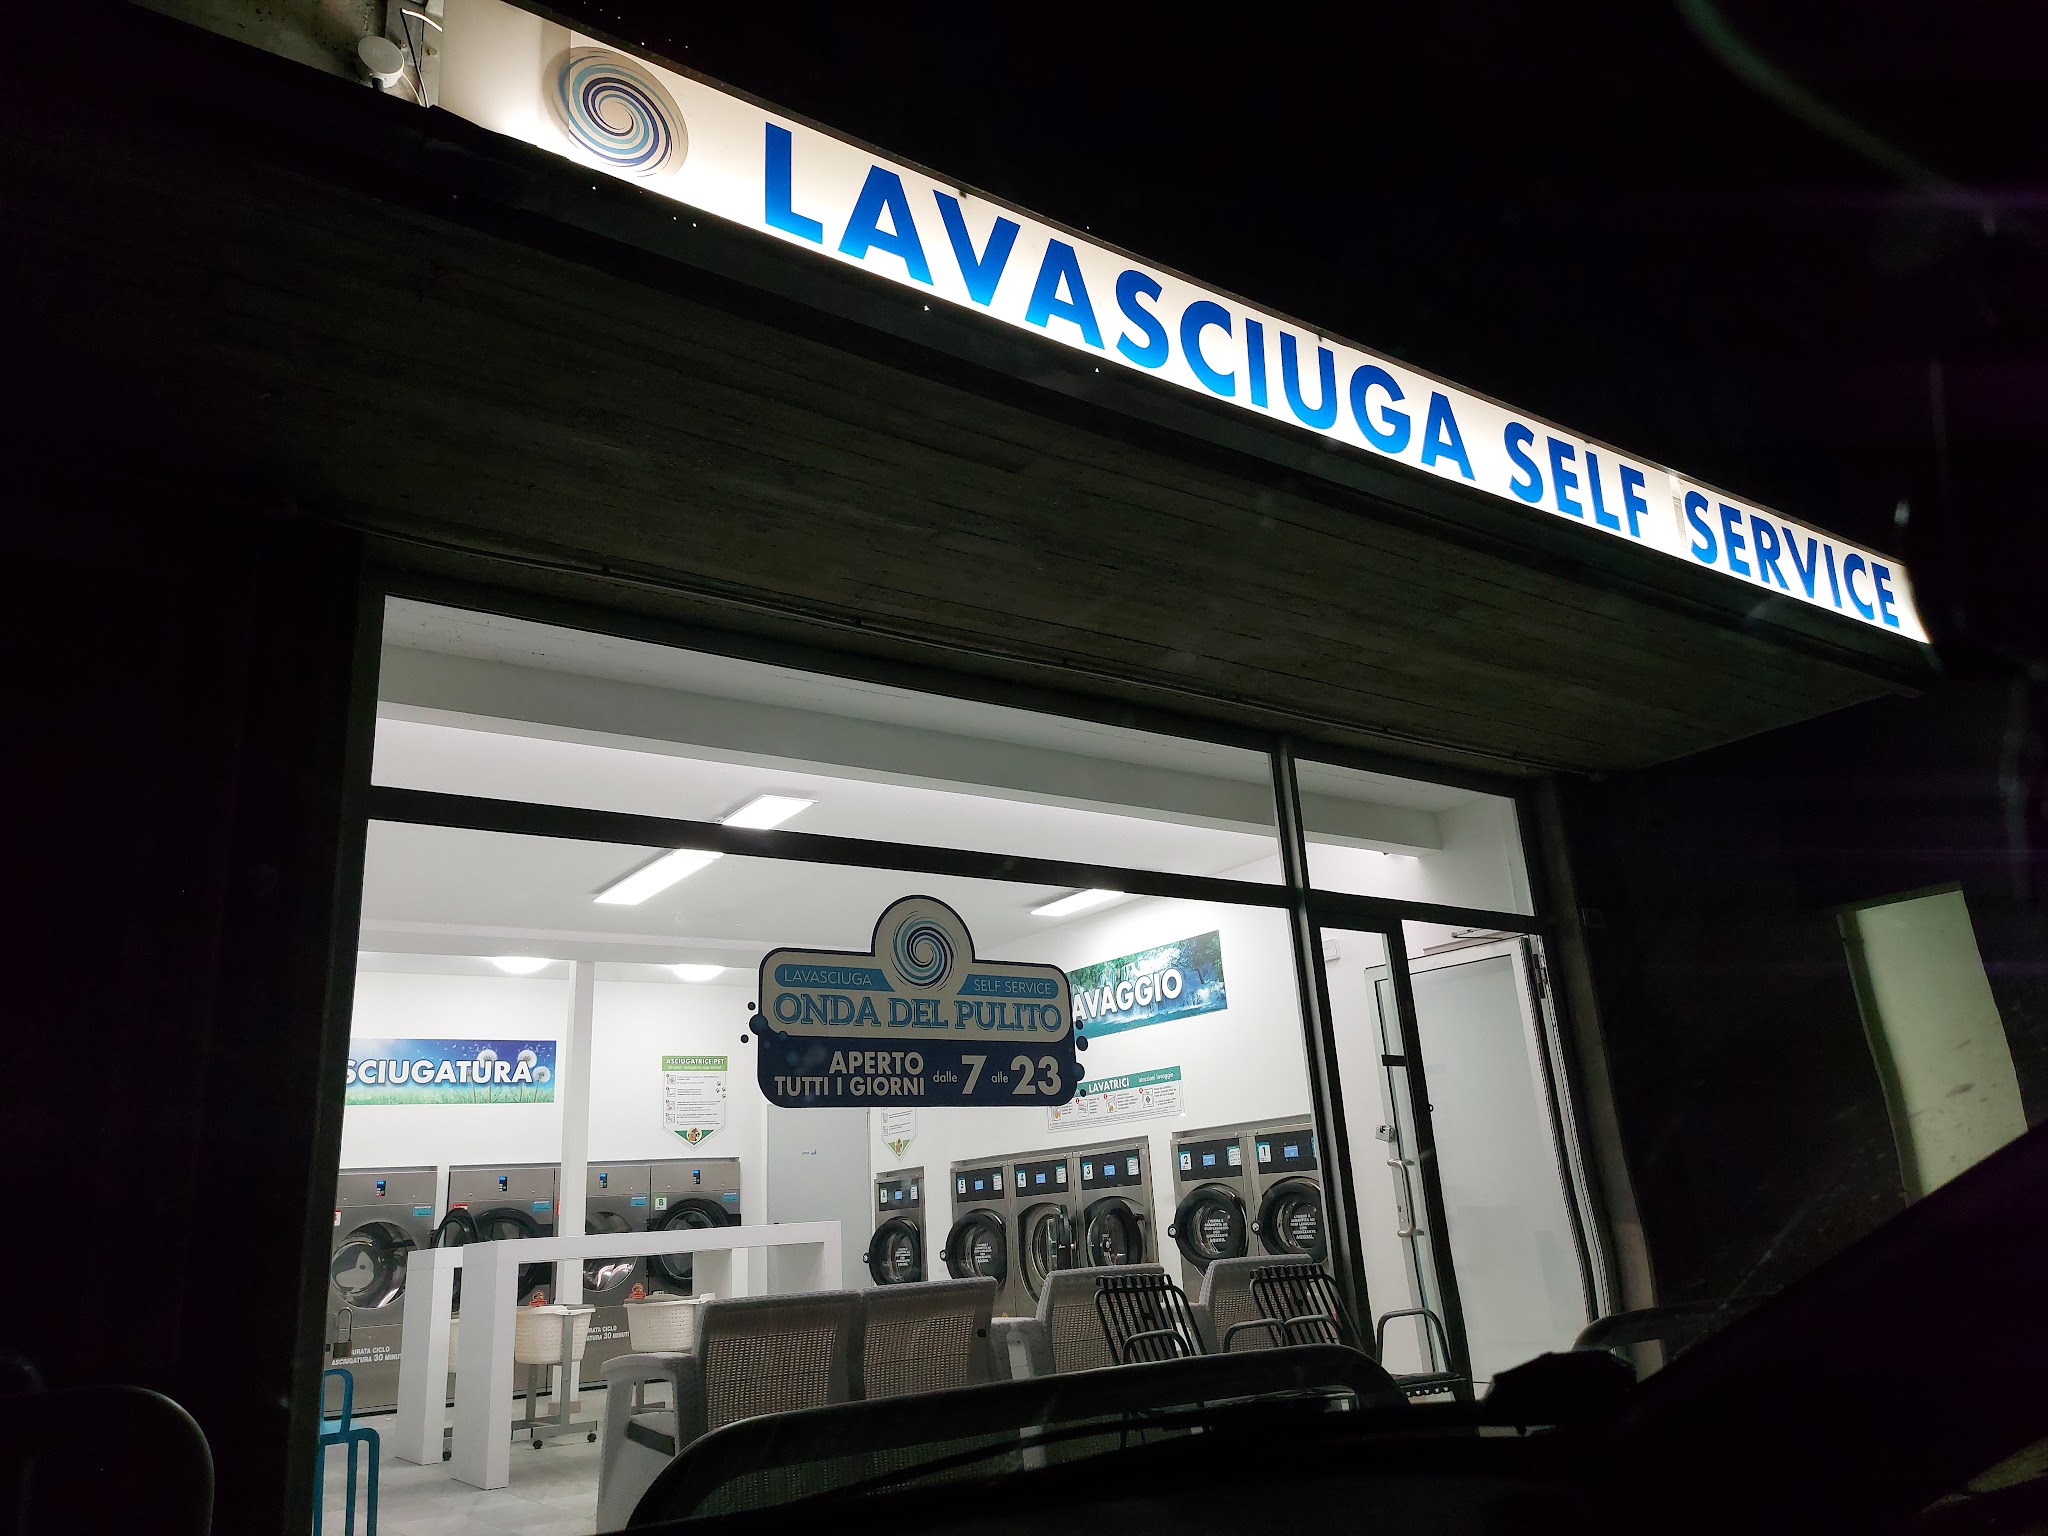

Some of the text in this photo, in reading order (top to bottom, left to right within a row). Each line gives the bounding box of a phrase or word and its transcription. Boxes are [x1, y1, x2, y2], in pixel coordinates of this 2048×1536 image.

[765, 121, 1901, 628] LAVASCIUGA SELF SERVICE
[784, 968, 1051, 995] LAVASCIUGA SELF SERVICE
[1072, 967, 1183, 1022] AVAGGIO
[773, 992, 1062, 1032] ONDA DEL PULITO
[346, 1058, 533, 1085] SCIUGATURA
[828, 1050, 924, 1075] APERTO
[932, 1055, 1062, 1096] dalle 7 alle 23
[774, 1076, 925, 1096] TUTTI I GIORNI
[1088, 1077, 1130, 1094] LAVATRICI
[331, 1353, 402, 1366] ASCIUGATURA 30 MINU
